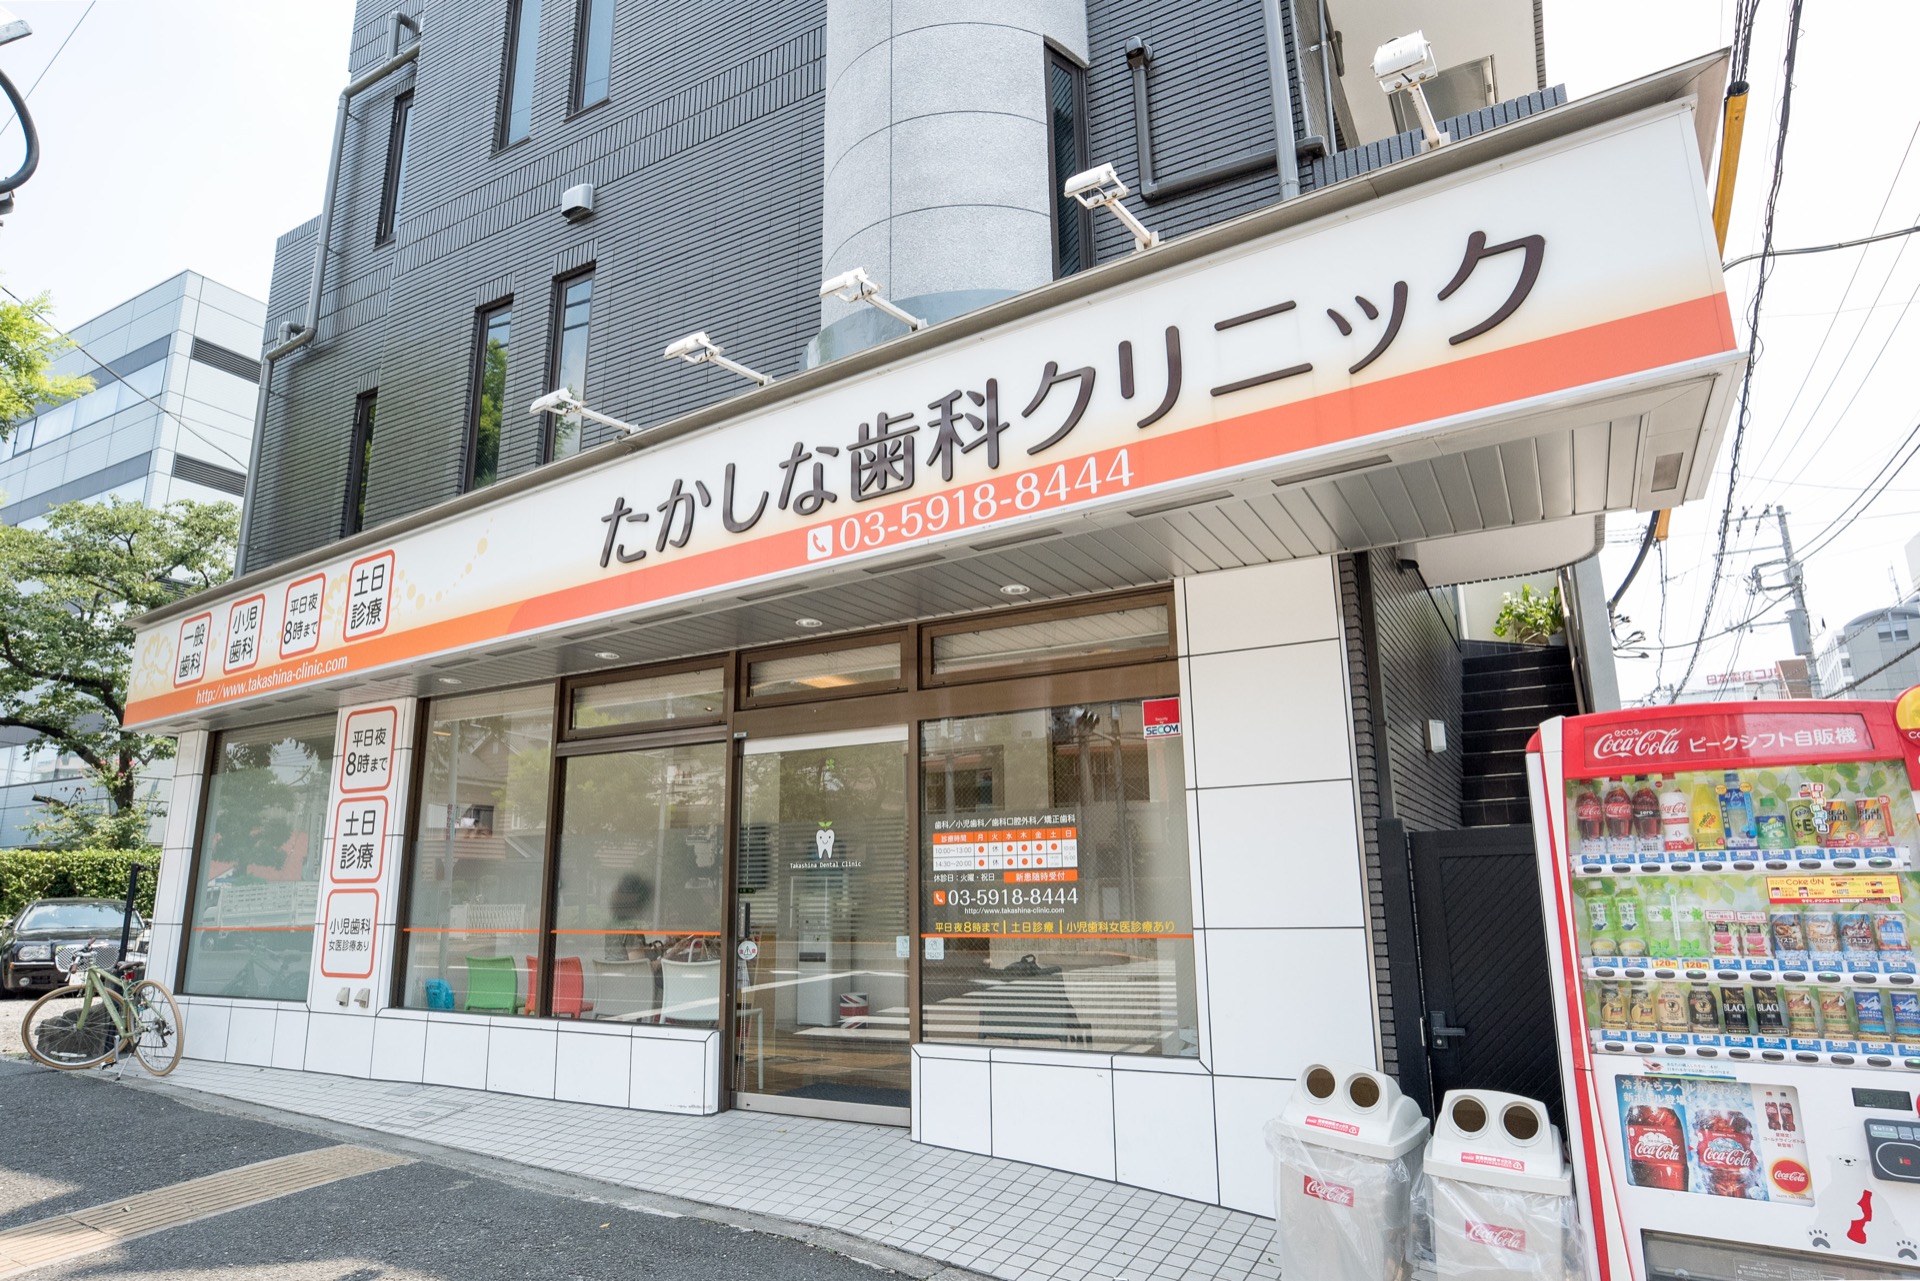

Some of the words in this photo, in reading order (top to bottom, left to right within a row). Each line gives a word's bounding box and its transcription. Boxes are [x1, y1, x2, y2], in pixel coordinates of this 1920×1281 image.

[599, 230, 1546, 569] たかしな歯科クリニック
[838, 448, 1135, 552] 03-5918-8444
[353, 563, 385, 597] 土日
[289, 593, 318, 617] 平日夜
[350, 597, 382, 630] 診療
[233, 605, 258, 634] 小児
[283, 619, 318, 645] 8時まで
[183, 623, 205, 647] 一般
[229, 636, 254, 663] 歯科
[179, 651, 201, 678] 歯科
[195, 654, 347, 706] http://www.takashina-clinic.com
[352, 727, 386, 747] 平日夜
[1145, 724, 1179, 735] SECOM
[1689, 726, 1858, 753] ピークシフト自販機
[345, 751, 388, 776] 8時まで
[343, 810, 376, 837] 土日
[977, 833, 984, 841] 月
[1035, 831, 1042, 839] 金
[339, 844, 374, 869] 診療
[948, 887, 1078, 906] 03-5918-8444
[964, 906, 1065, 914] http://www.takashina-clinic.com
[329, 917, 371, 935] 小児歯科
[935, 921, 999, 933] 平日夜8時まで
[1011, 921, 1055, 933] 土日診療
[1066, 920, 1176, 933] 小児歯科女医診療あり
[328, 939, 369, 952] 女医診療あり
